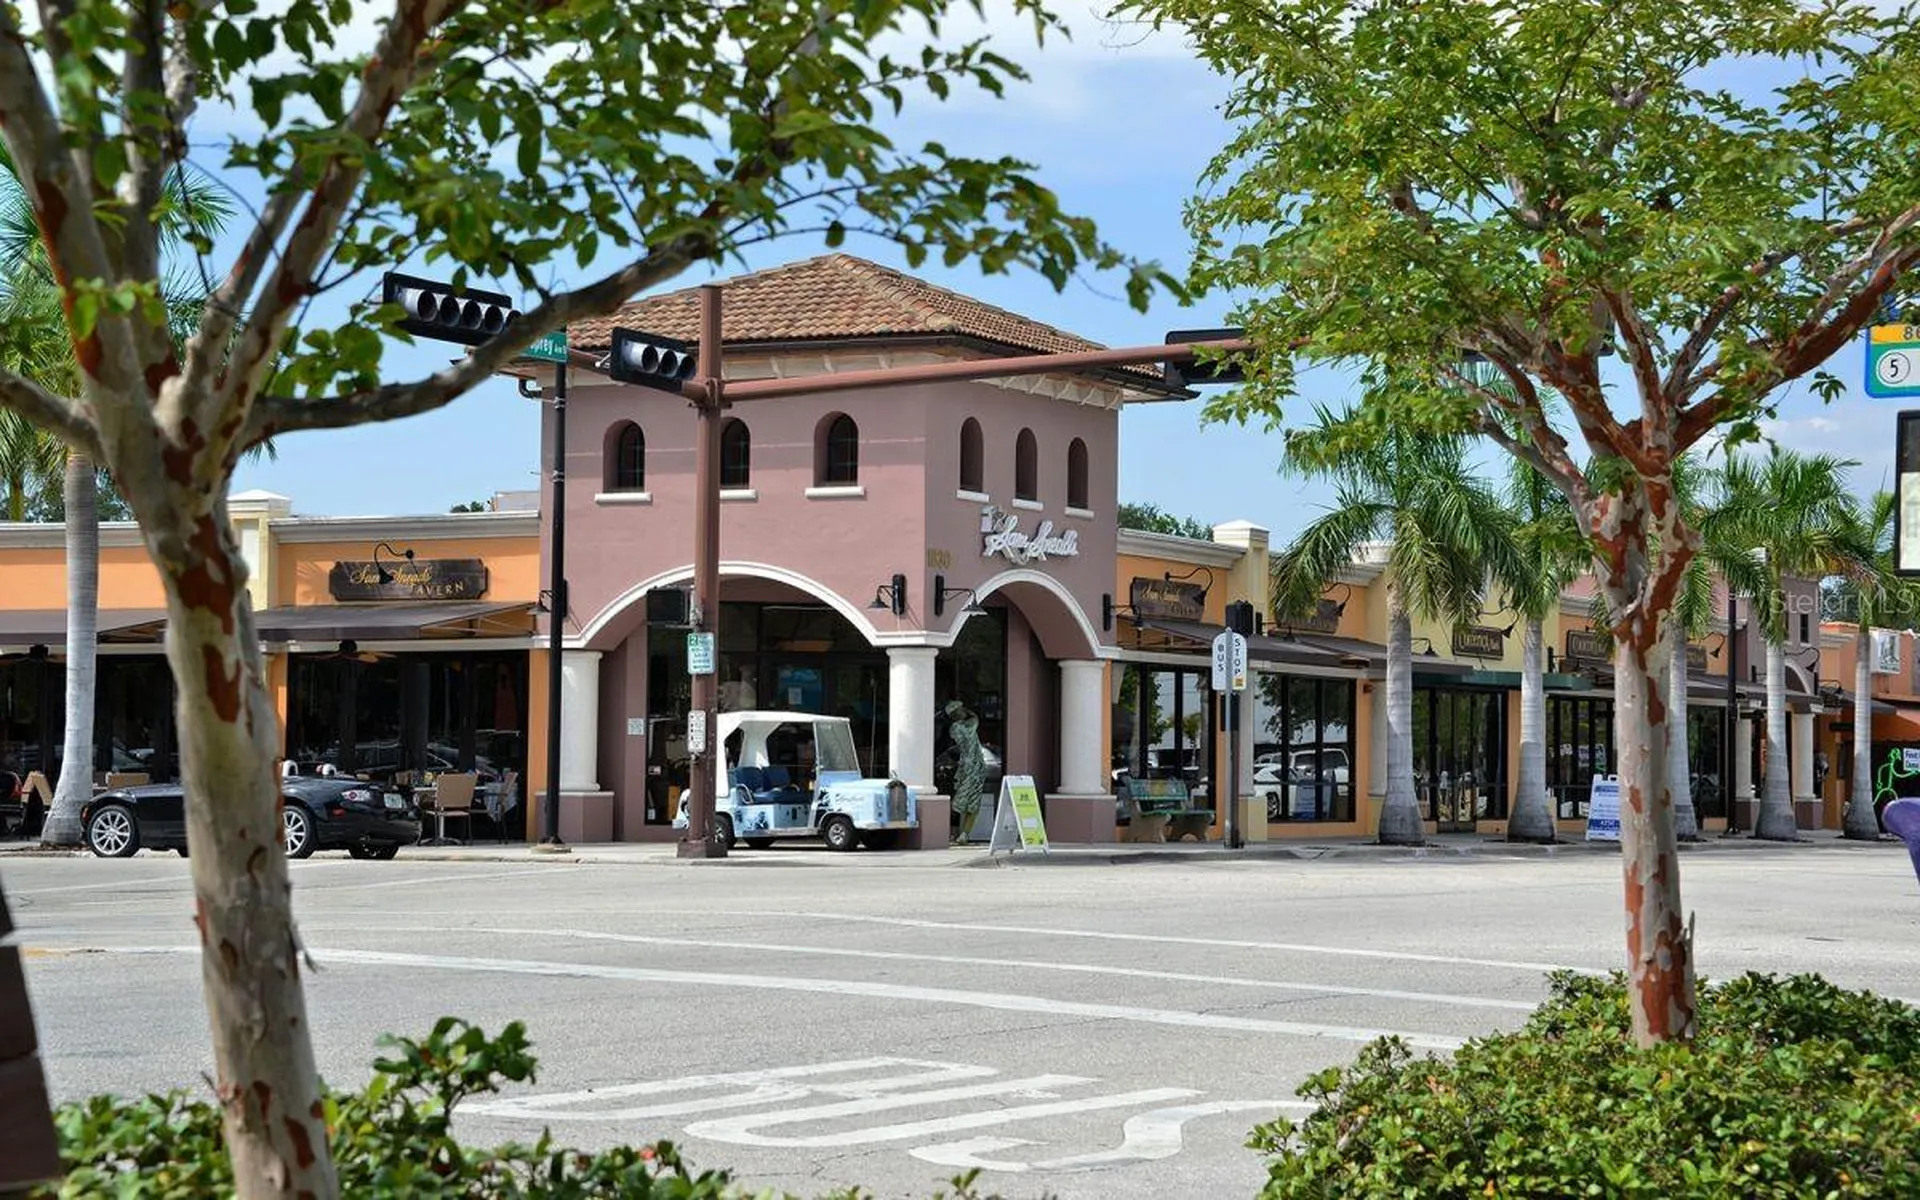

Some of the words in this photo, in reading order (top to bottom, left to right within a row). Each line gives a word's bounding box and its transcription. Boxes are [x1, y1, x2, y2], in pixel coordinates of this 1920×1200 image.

[1890, 359, 1899, 378] 5
[411, 581, 465, 597] TAVERN
[1217, 644, 1225, 672] BUS
